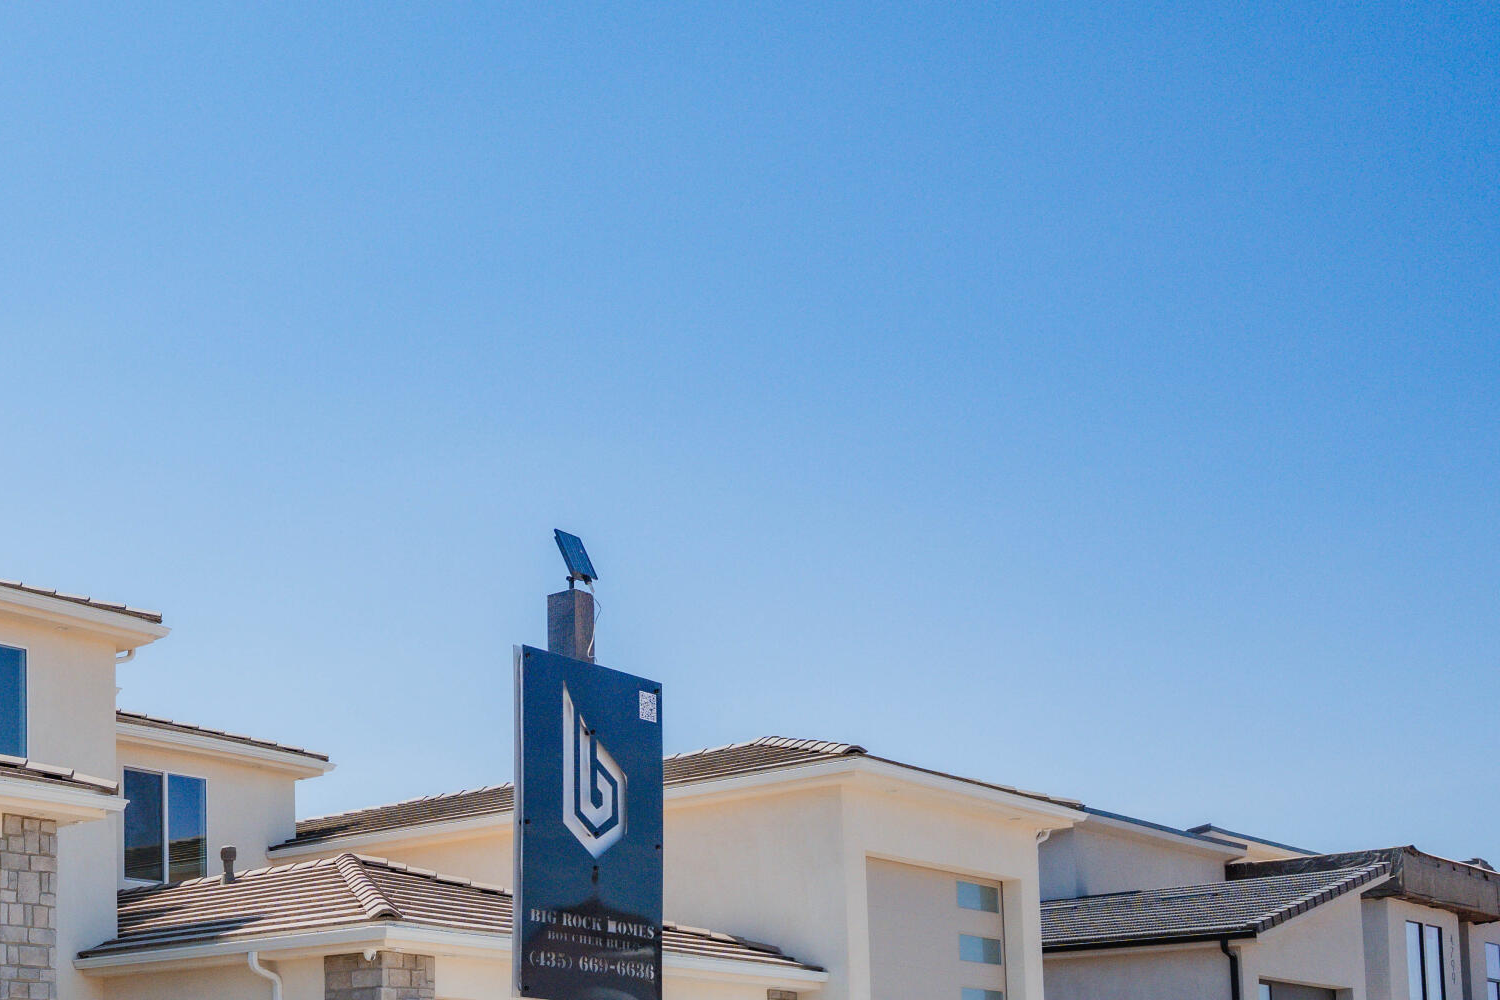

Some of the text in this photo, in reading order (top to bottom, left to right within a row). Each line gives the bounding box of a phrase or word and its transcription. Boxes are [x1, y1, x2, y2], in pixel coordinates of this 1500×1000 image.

[530, 909, 557, 924] BIG
[562, 911, 603, 931] ROCK
[606, 938, 640, 951] BUIL
[529, 951, 655, 980] (435) 669-6636
